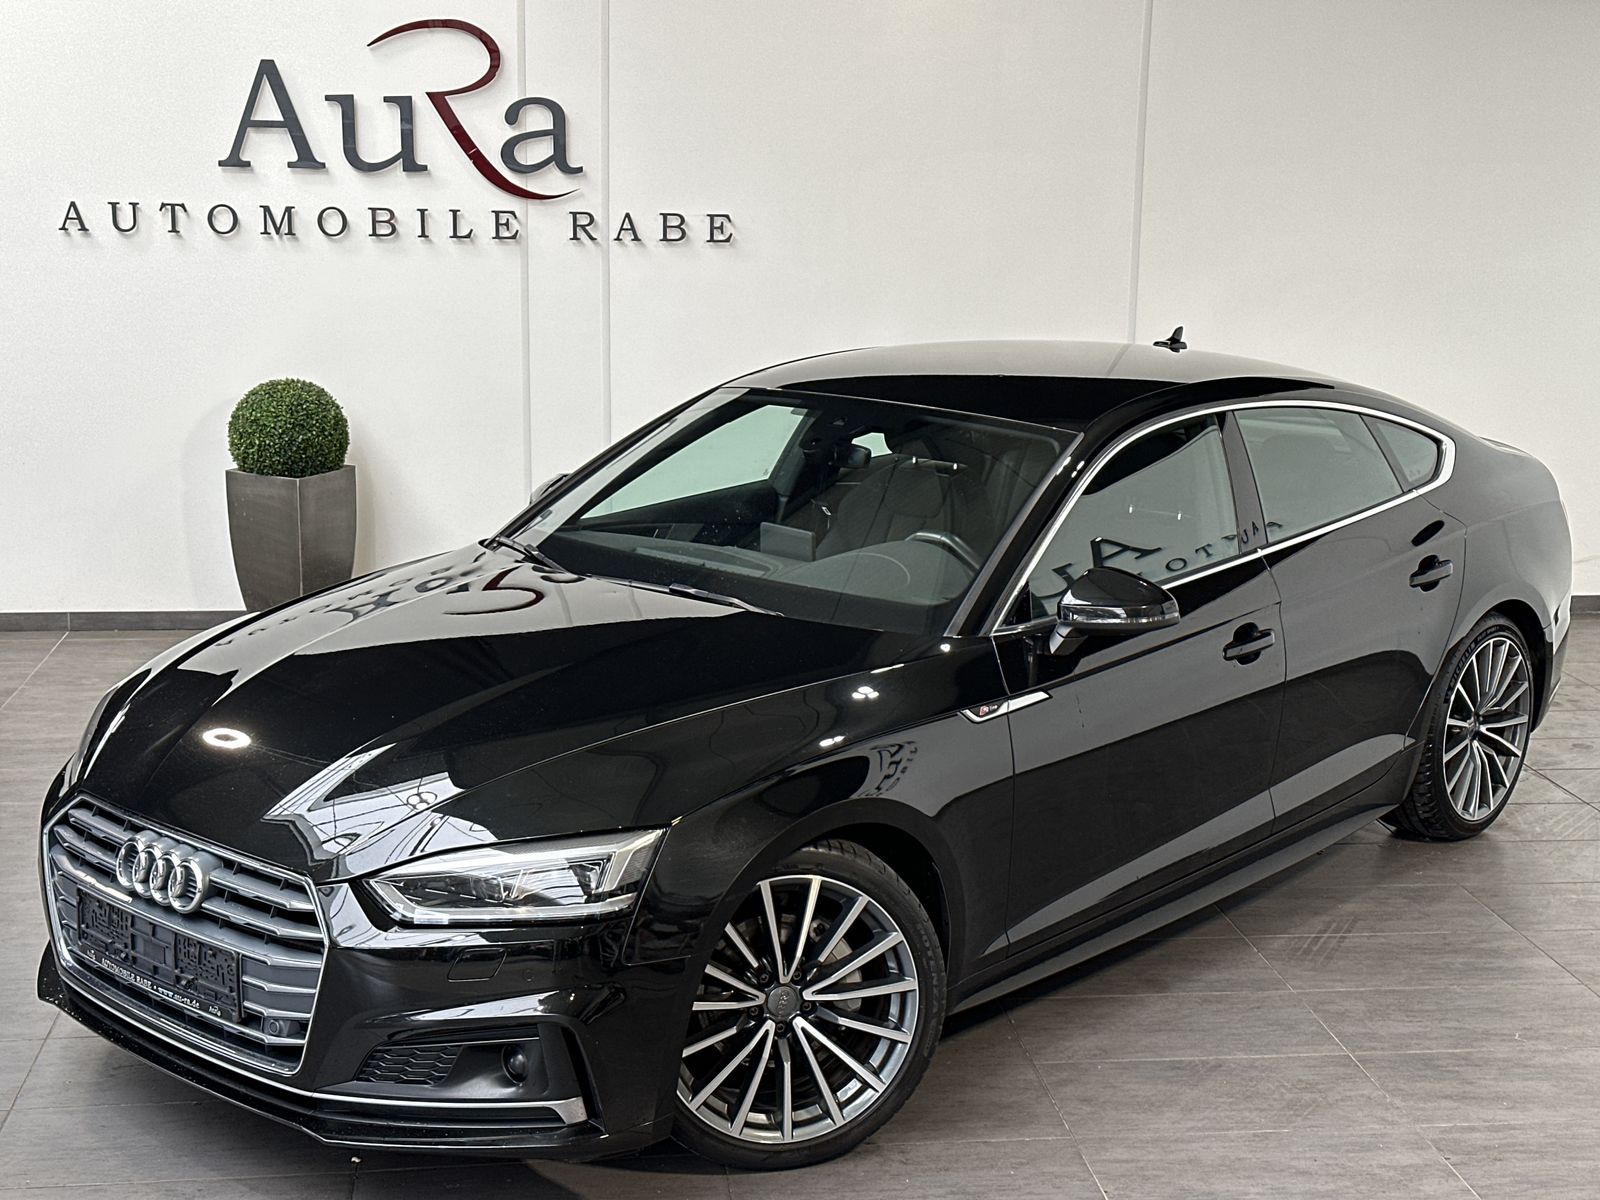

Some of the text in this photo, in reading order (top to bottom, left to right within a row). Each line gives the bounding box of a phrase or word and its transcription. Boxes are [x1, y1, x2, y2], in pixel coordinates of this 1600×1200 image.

[218, 18, 584, 201] AuRa
[58, 200, 734, 244] AUTOMOBILE RABE
